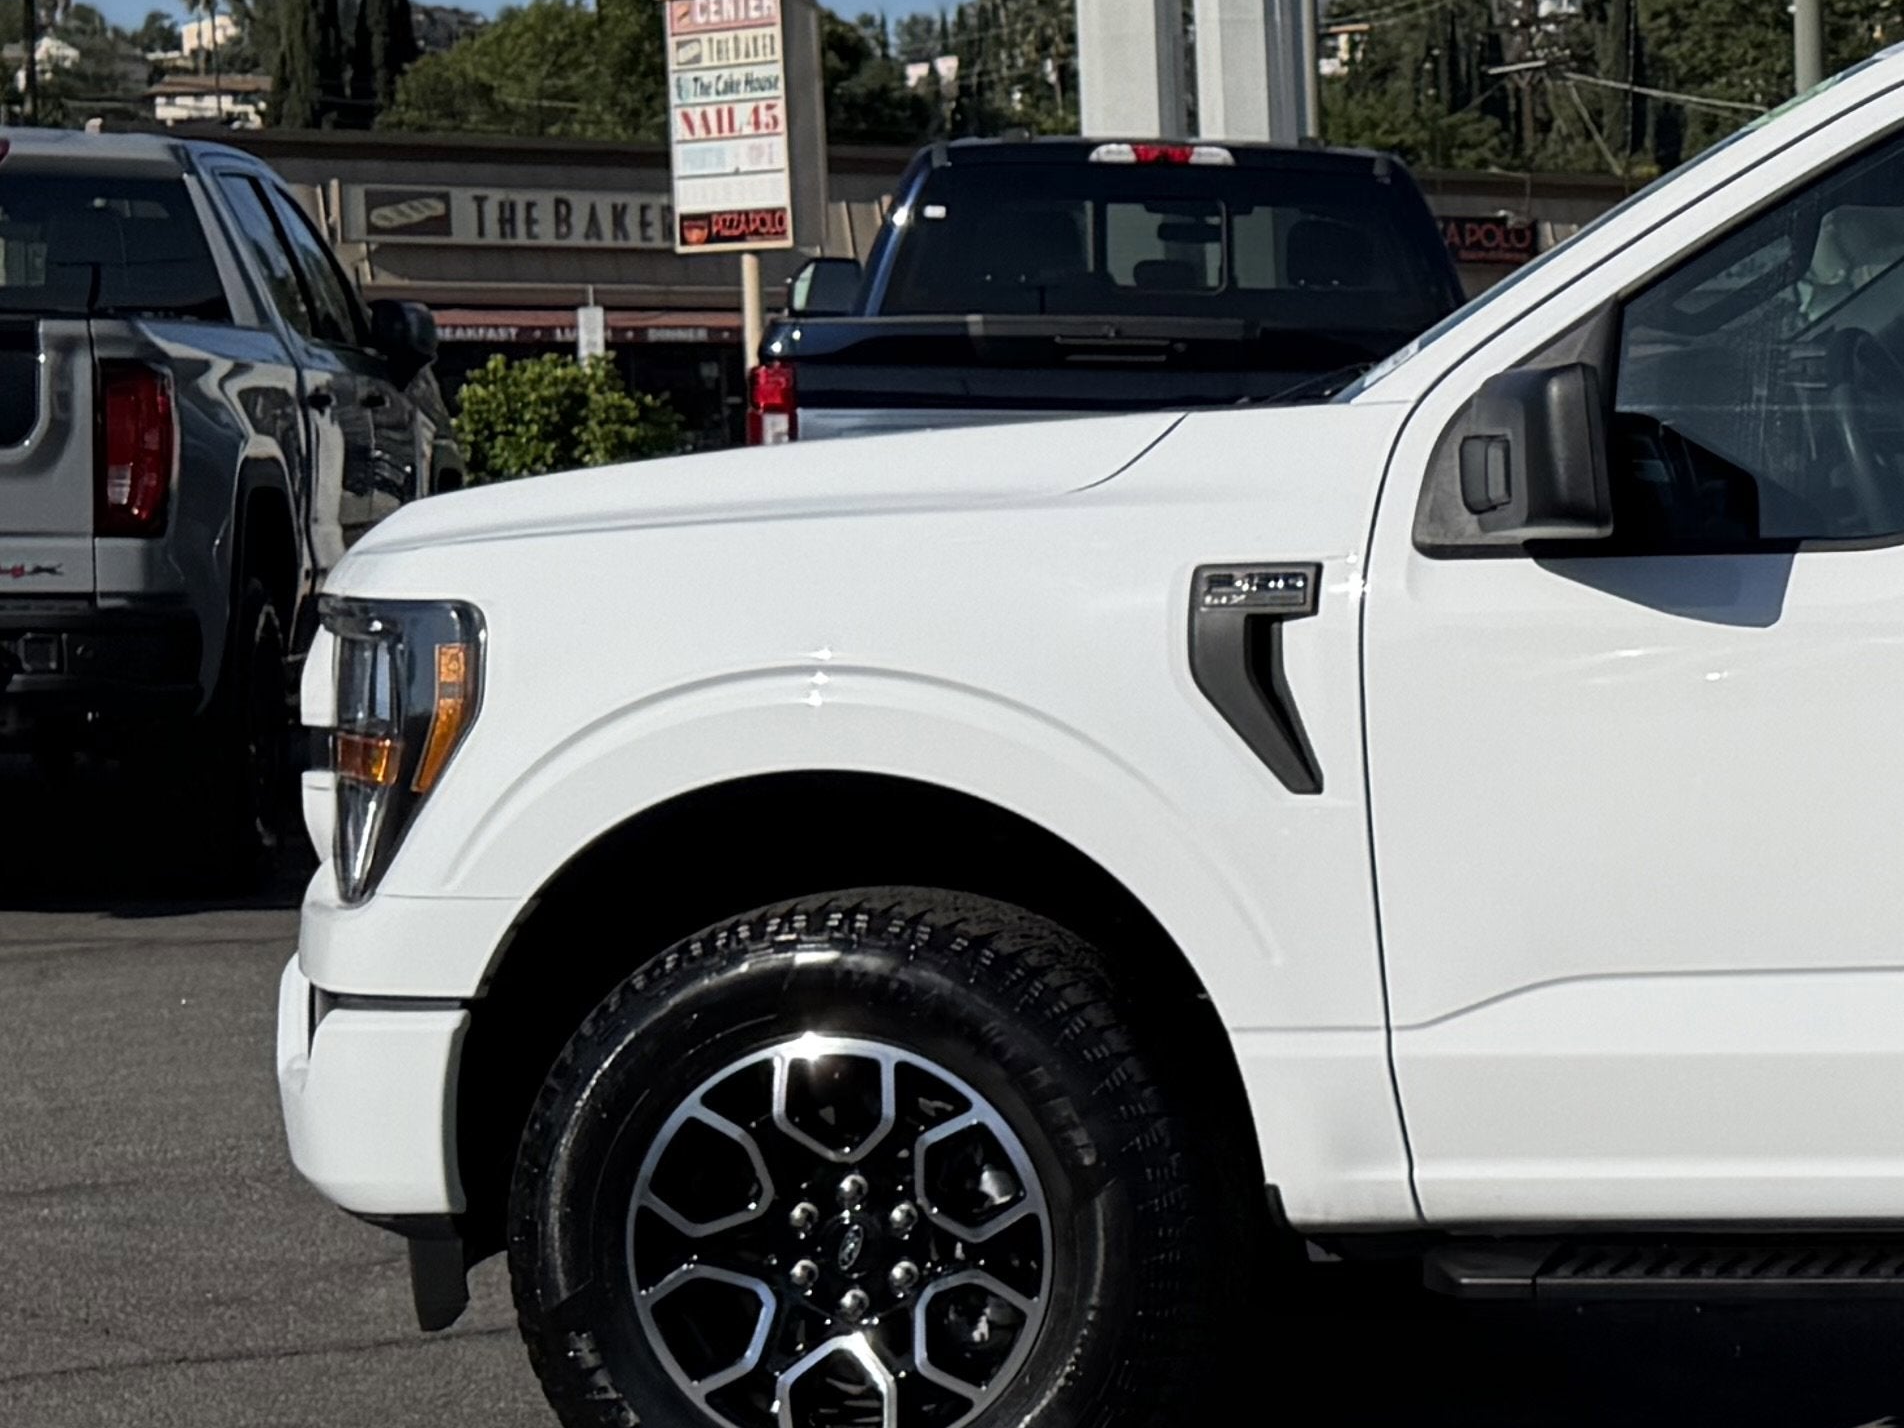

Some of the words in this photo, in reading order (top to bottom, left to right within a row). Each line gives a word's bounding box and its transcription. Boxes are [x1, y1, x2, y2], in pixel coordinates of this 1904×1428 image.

[733, 33, 776, 61] BAKER
[692, 76, 712, 98] The
[715, 73, 742, 98] Cake
[743, 71, 780, 94] House
[681, 105, 741, 137] NAIL
[749, 103, 780, 133] 45
[472, 194, 539, 240] THE
